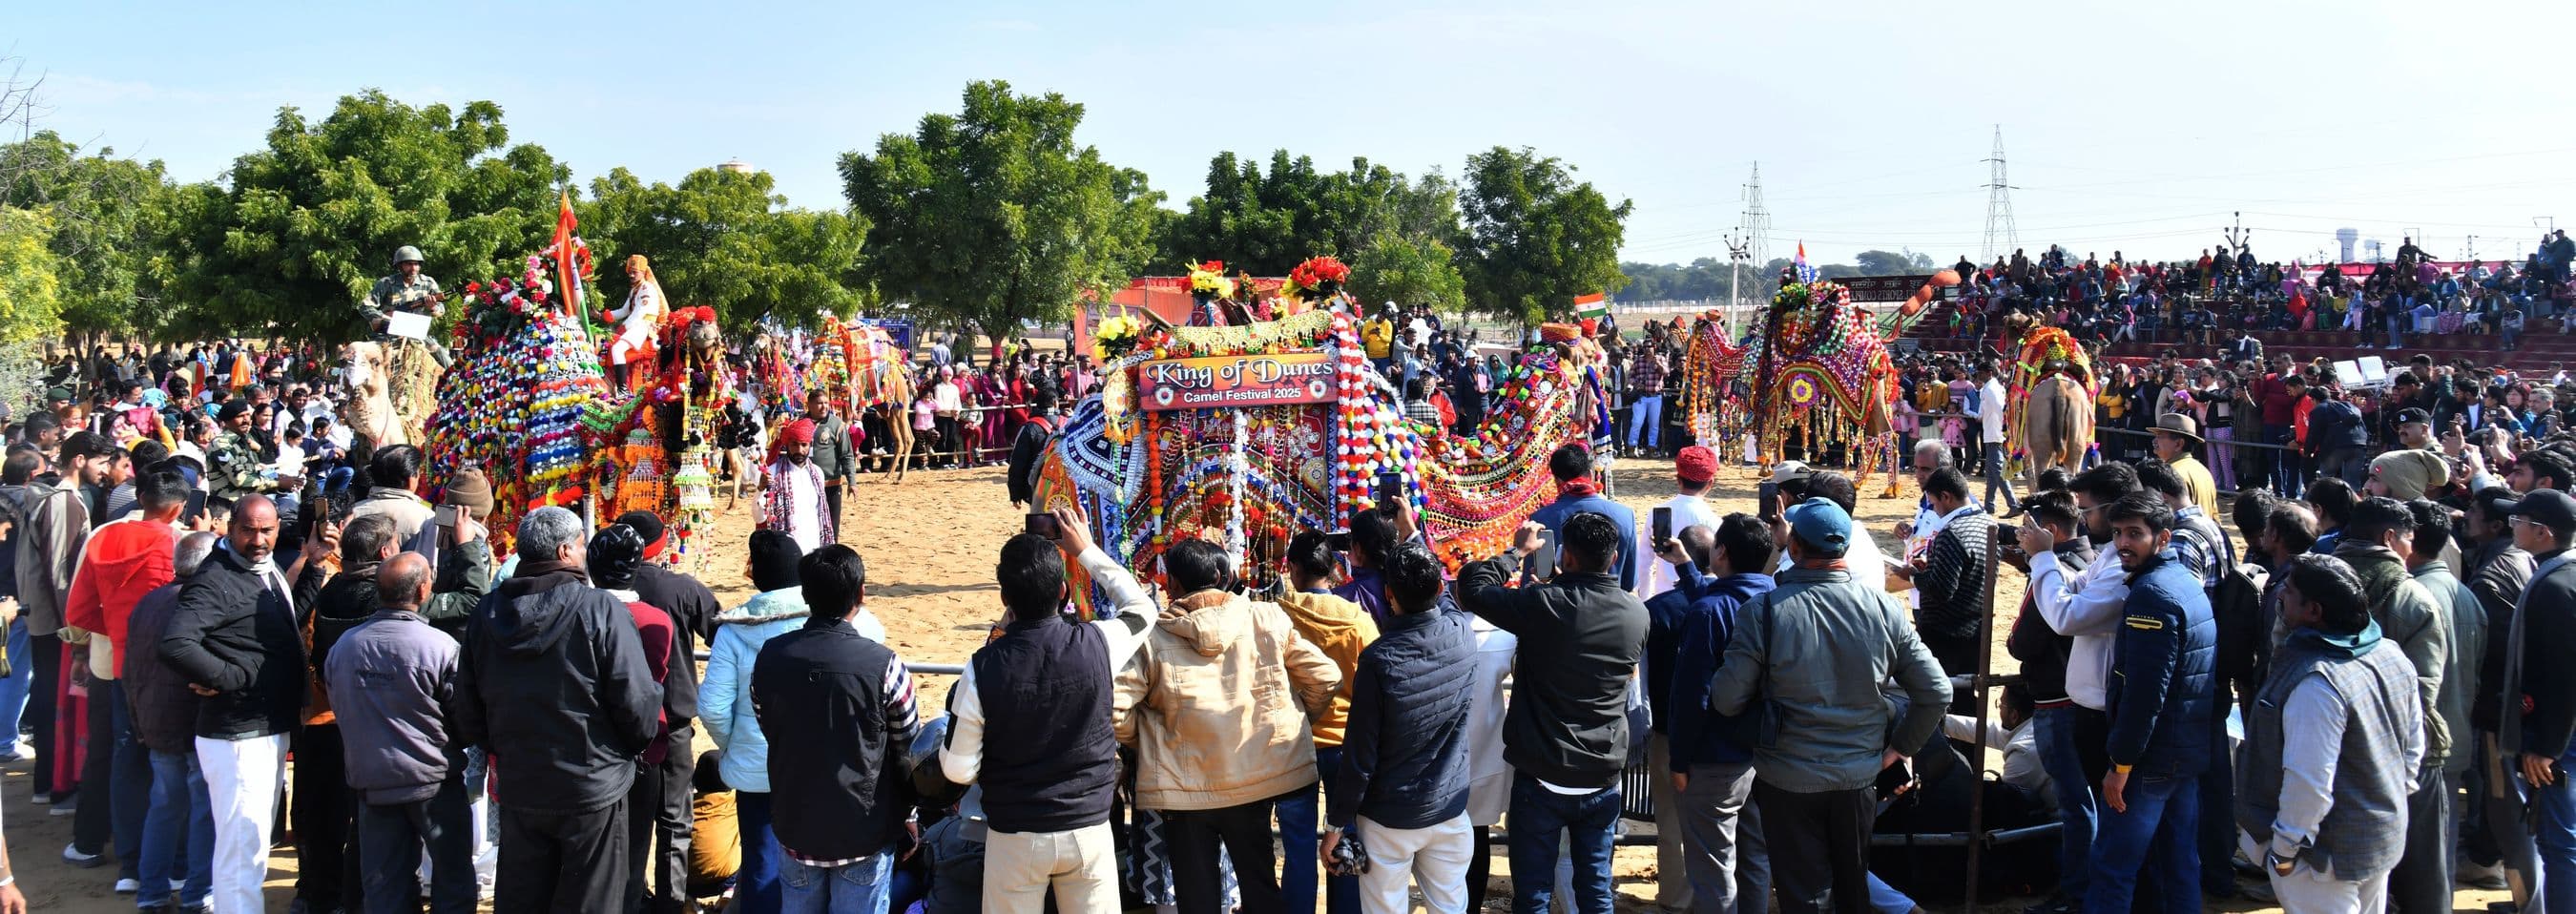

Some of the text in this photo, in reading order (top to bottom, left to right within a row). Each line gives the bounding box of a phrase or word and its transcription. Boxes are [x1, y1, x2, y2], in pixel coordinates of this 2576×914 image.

[1146, 359, 1334, 388] King of Dunes
[1183, 387, 1301, 403] Camel Festival 2025
